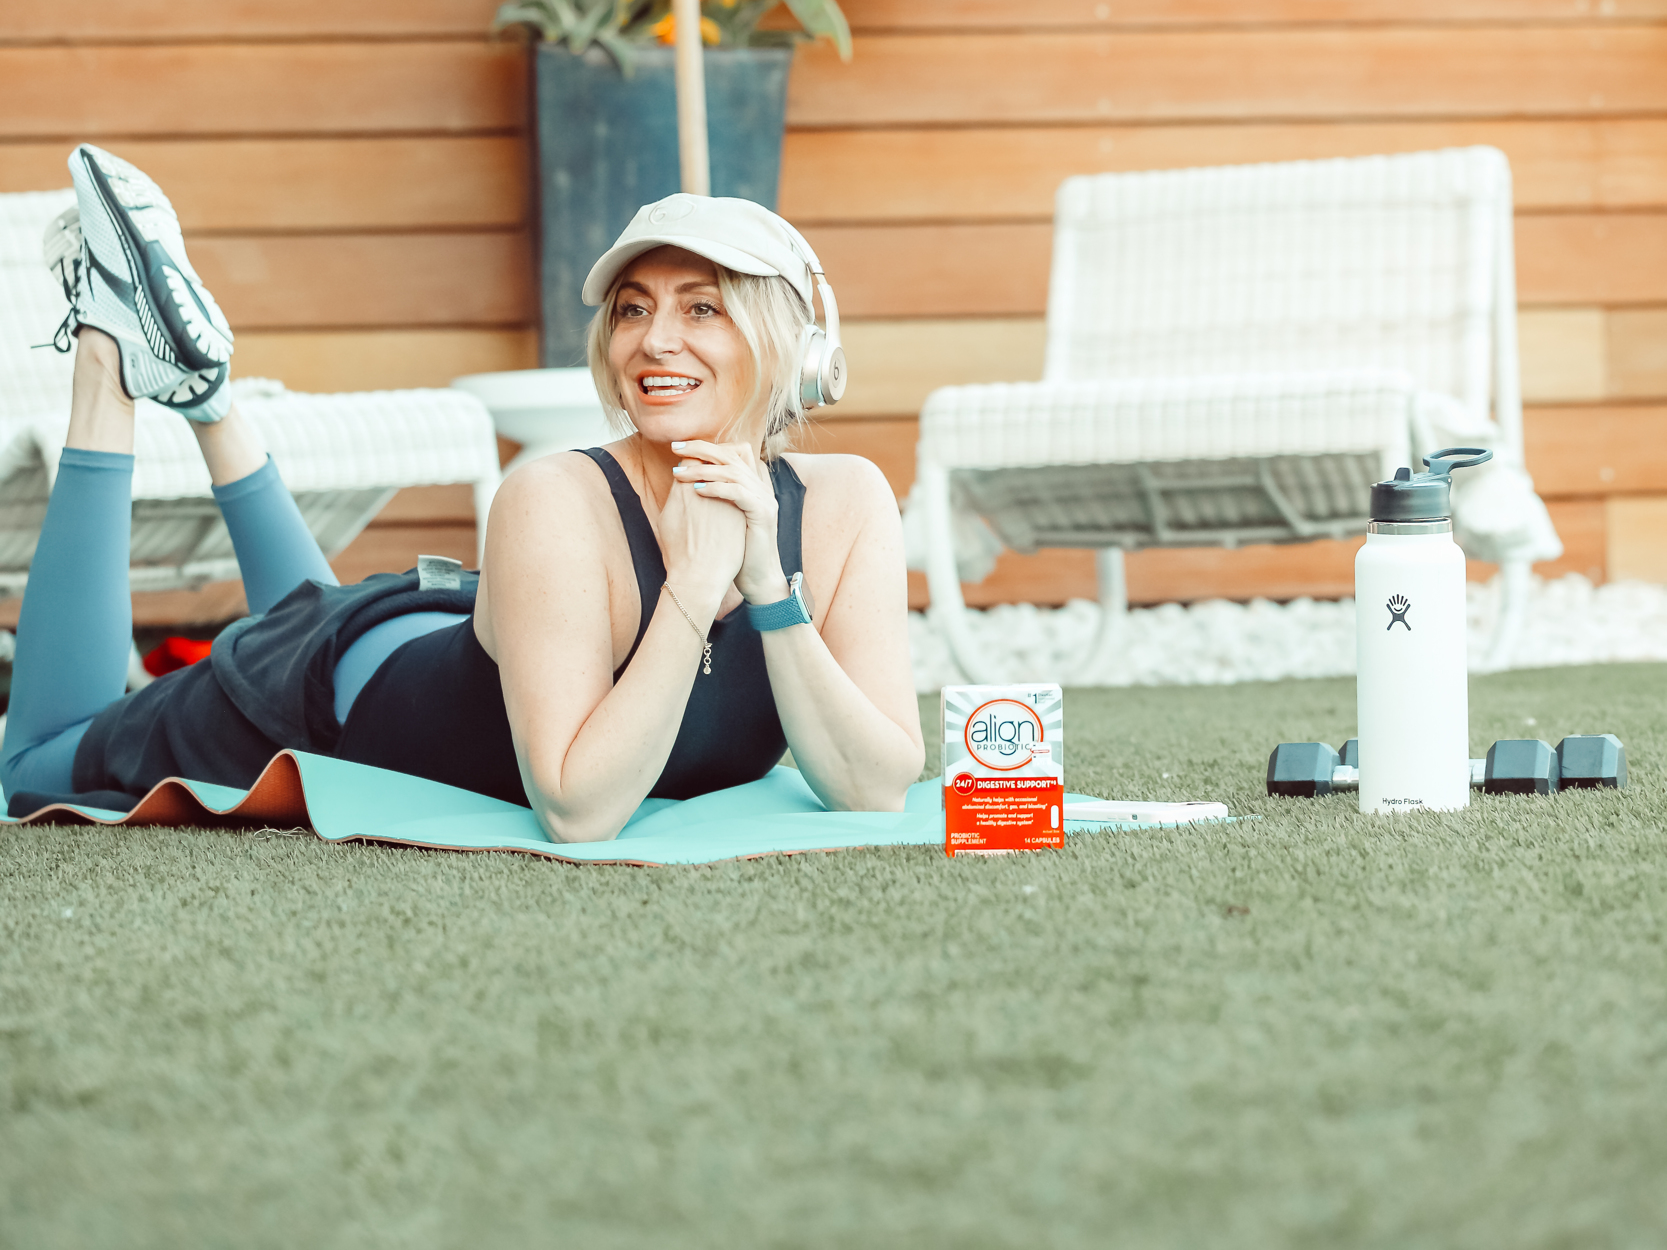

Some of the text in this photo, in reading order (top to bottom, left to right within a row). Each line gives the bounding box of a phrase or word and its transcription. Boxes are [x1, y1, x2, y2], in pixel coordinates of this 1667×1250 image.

[971, 713, 1035, 756] align
[976, 743, 1031, 751] PROBIOTIC
[955, 779, 972, 788] 24/7
[977, 780, 1016, 789] DIGESTIVE
[1382, 798, 1403, 806] Hydro
